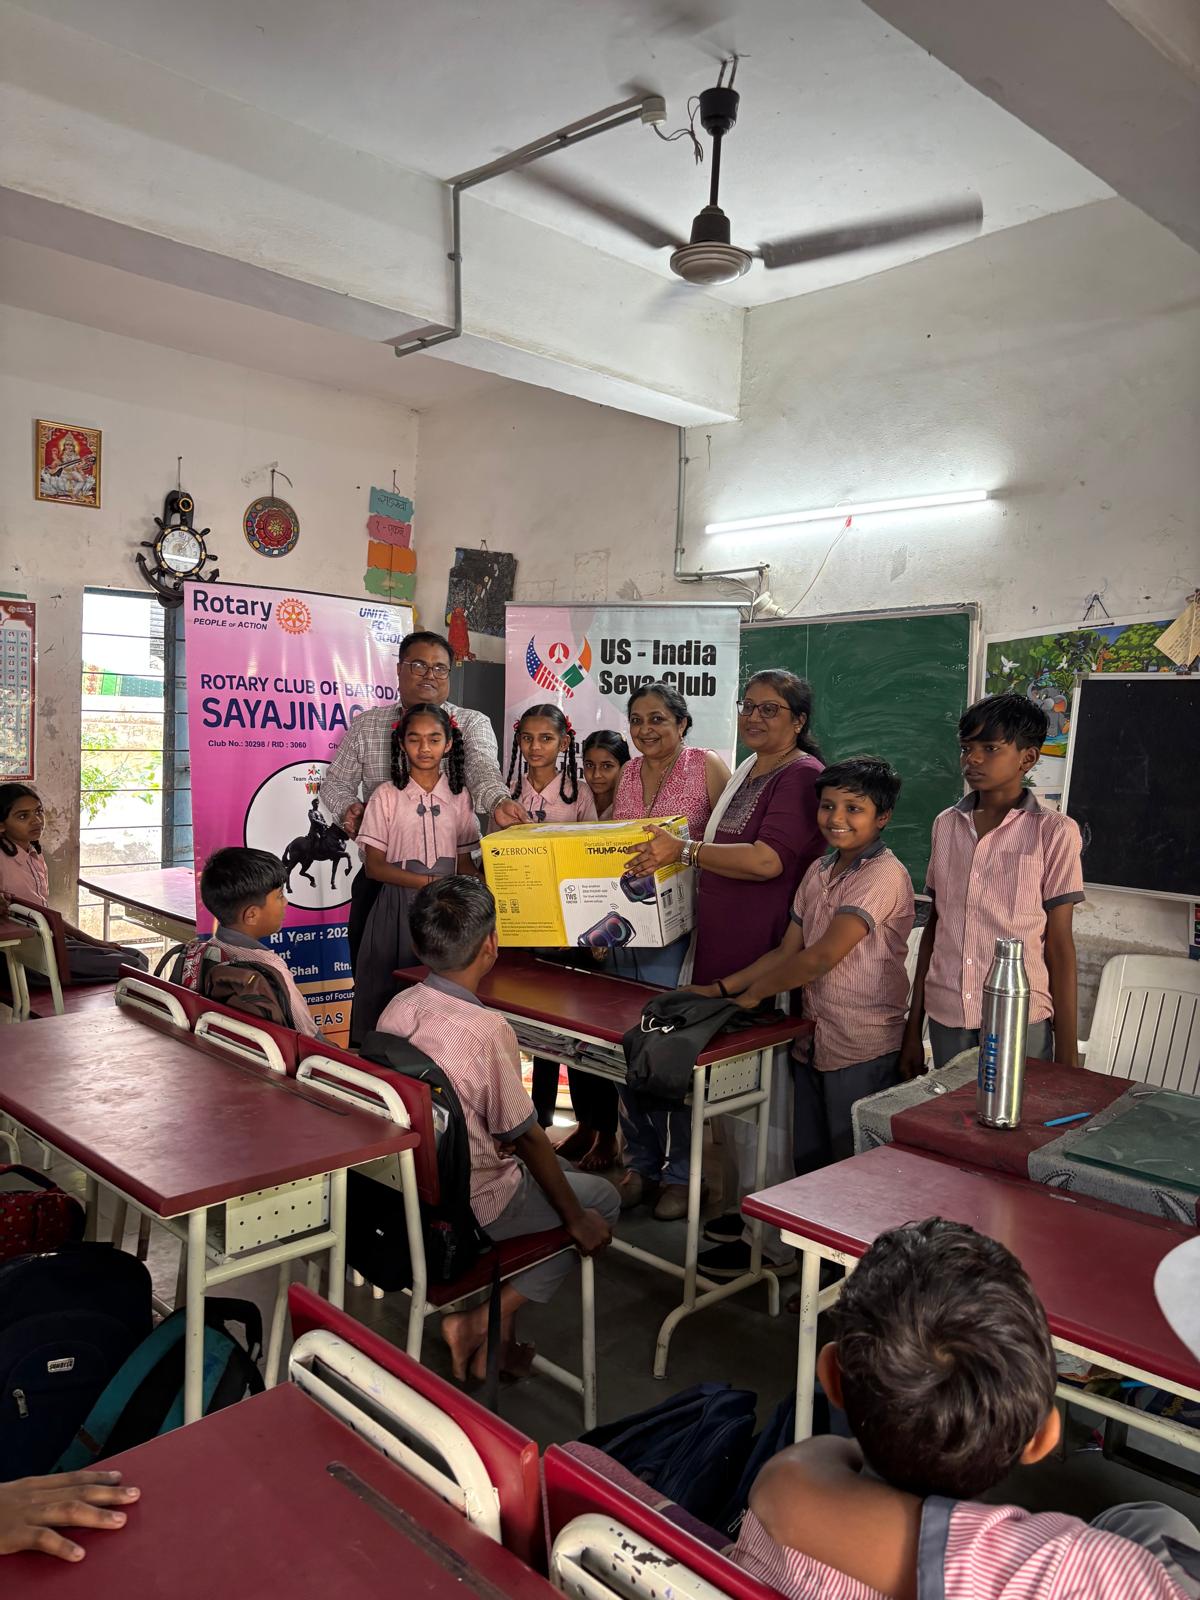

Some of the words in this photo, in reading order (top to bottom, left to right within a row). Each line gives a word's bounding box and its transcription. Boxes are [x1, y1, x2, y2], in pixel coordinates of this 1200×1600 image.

[193, 590, 272, 621] Rotary
[359, 607, 389, 620] UNITE
[193, 617, 227, 627] PEOPLE
[237, 621, 268, 630] ACTION
[600, 638, 631, 665] US
[652, 640, 717, 666] India
[201, 674, 268, 692] ROTARY
[274, 678, 315, 694] CLUB
[320, 681, 338, 696] OF
[208, 740, 226, 748] Club
[500, 846, 548, 856] ZEBRONICS
[587, 846, 616, 855] THUMP
[617, 845, 633, 854] 40
[270, 932, 283, 944] RI
[287, 931, 316, 942] Year
[290, 965, 319, 976] Shah
[334, 961, 352, 971] Rtn.
[325, 993, 333, 1001] of
[334, 992, 355, 1000] Focus
[314, 1012, 344, 1026] EAS
